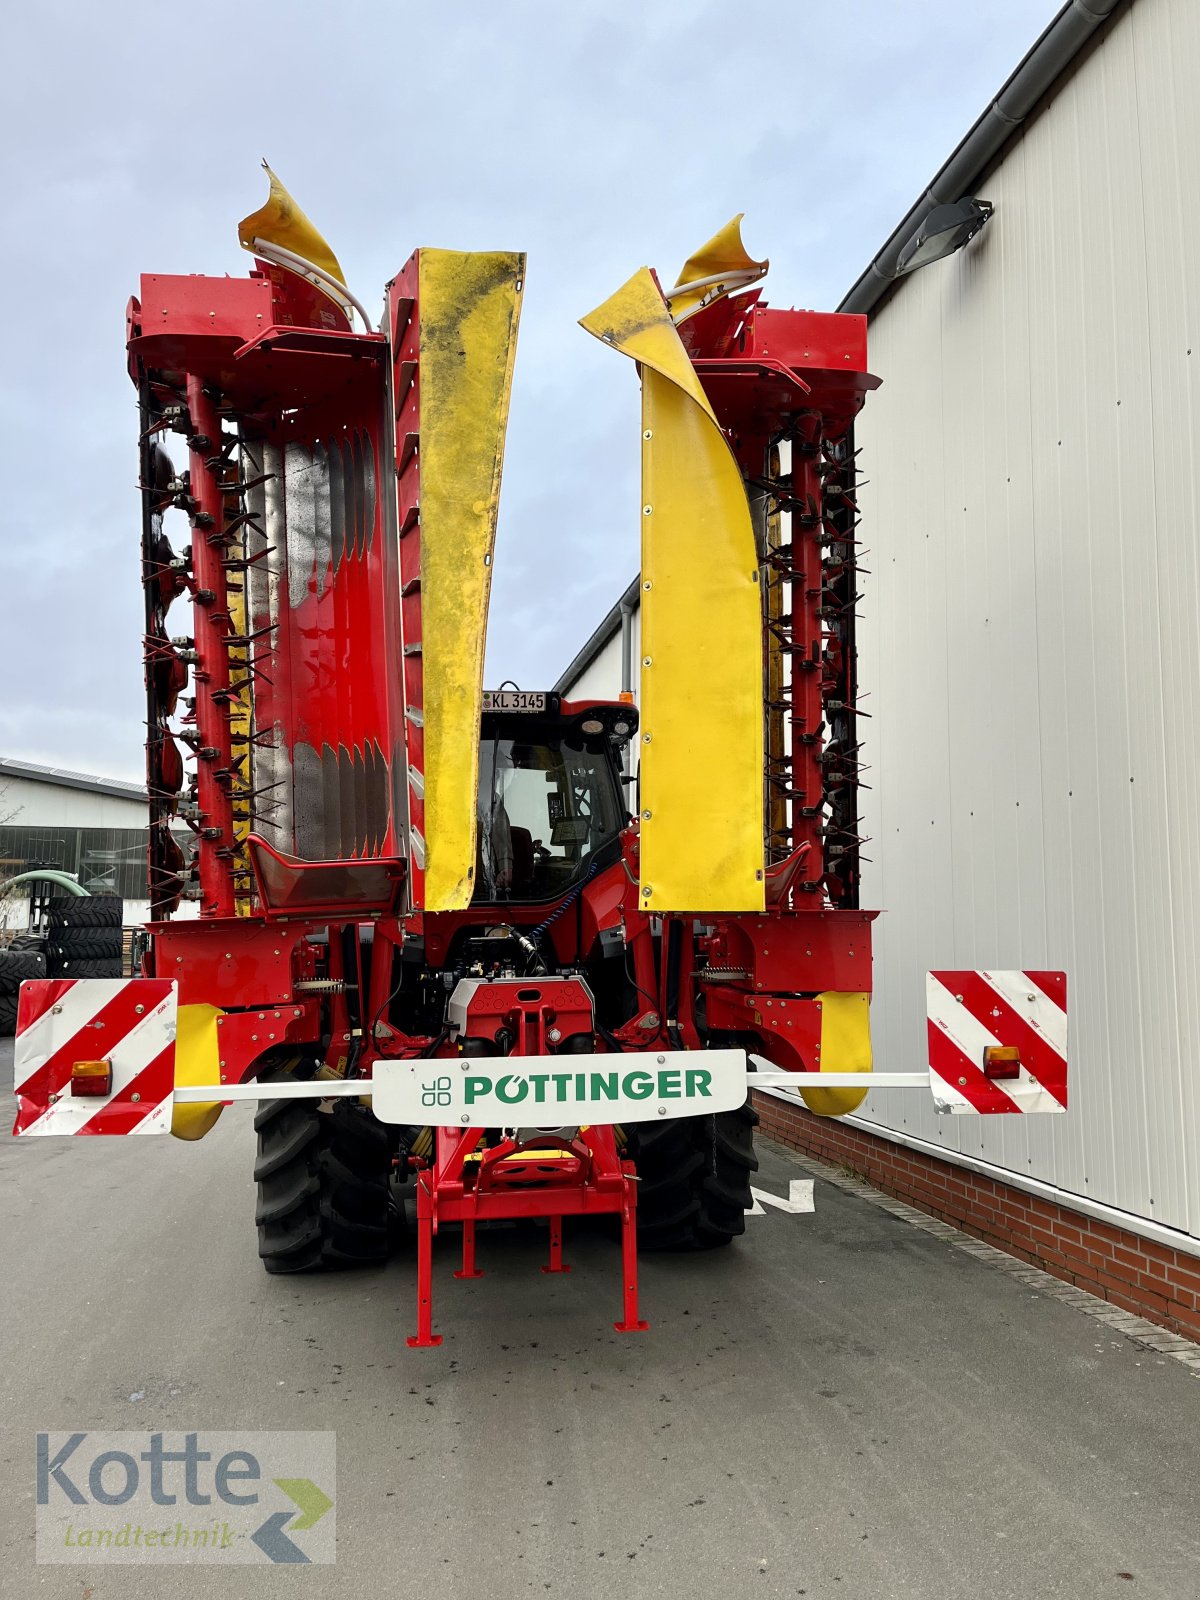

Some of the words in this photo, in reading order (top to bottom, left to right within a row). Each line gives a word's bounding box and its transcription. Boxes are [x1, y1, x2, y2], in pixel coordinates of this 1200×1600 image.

[492, 693, 509, 708] KL
[512, 694, 544, 708] 3145
[464, 1069, 713, 1105] PÖTTINGER
